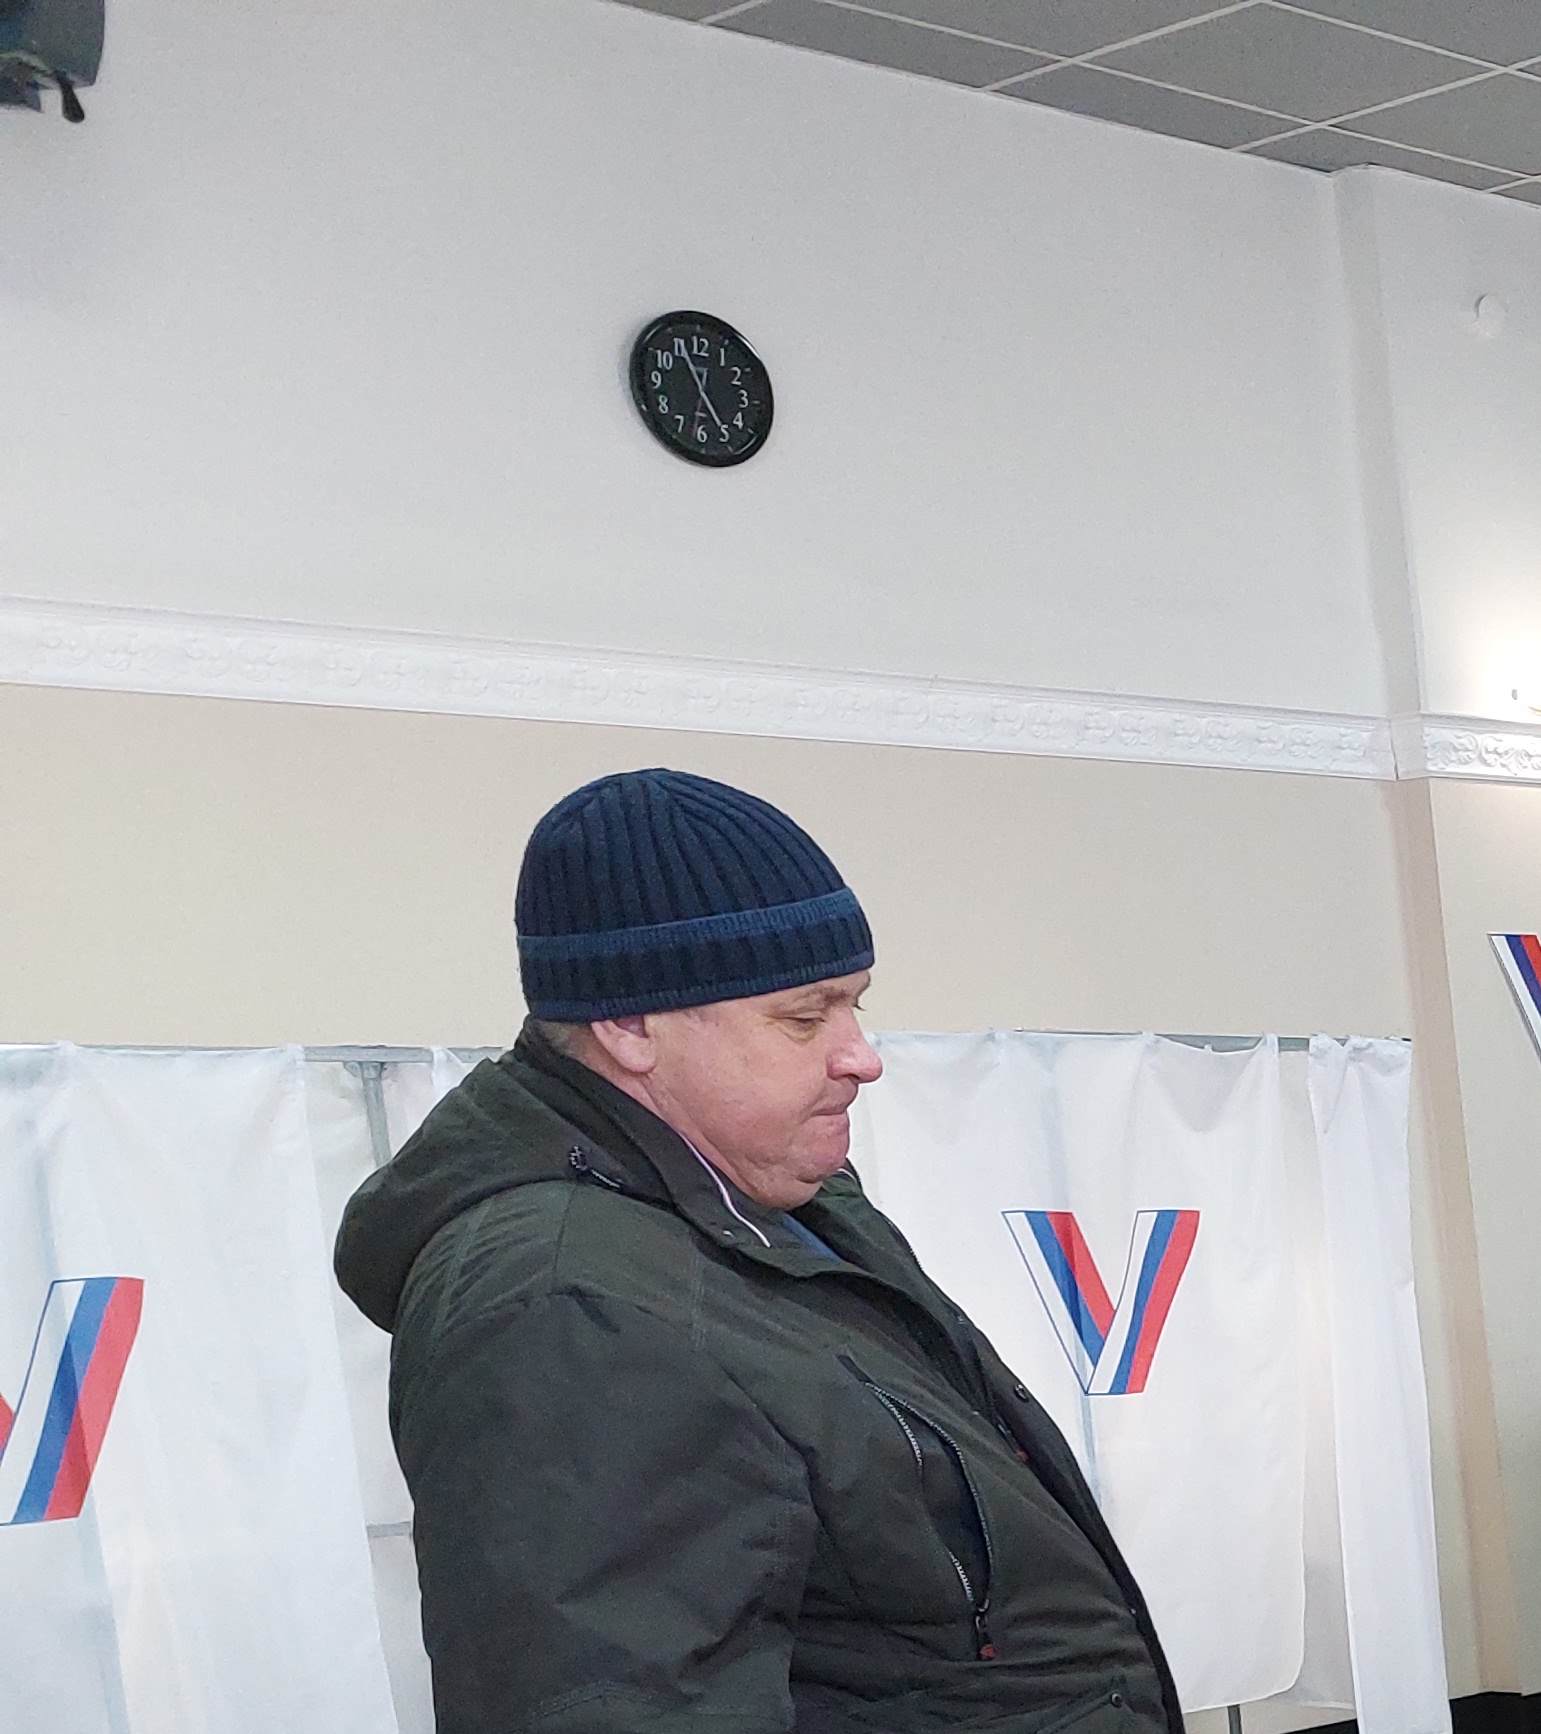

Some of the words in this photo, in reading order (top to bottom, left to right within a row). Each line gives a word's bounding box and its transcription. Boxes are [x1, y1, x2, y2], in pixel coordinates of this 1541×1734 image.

[691, 336, 709, 357] 12
[656, 350, 673, 370] 10
[719, 348, 726, 366] 1
[651, 371, 662, 389] 9
[730, 367, 742, 385] 2
[658, 395, 669, 414] 8
[738, 390, 749, 408] 3
[674, 415, 685, 433] 7
[733, 412, 744, 429] 4
[697, 425, 708, 443] 6
[719, 424, 730, 442] 5
